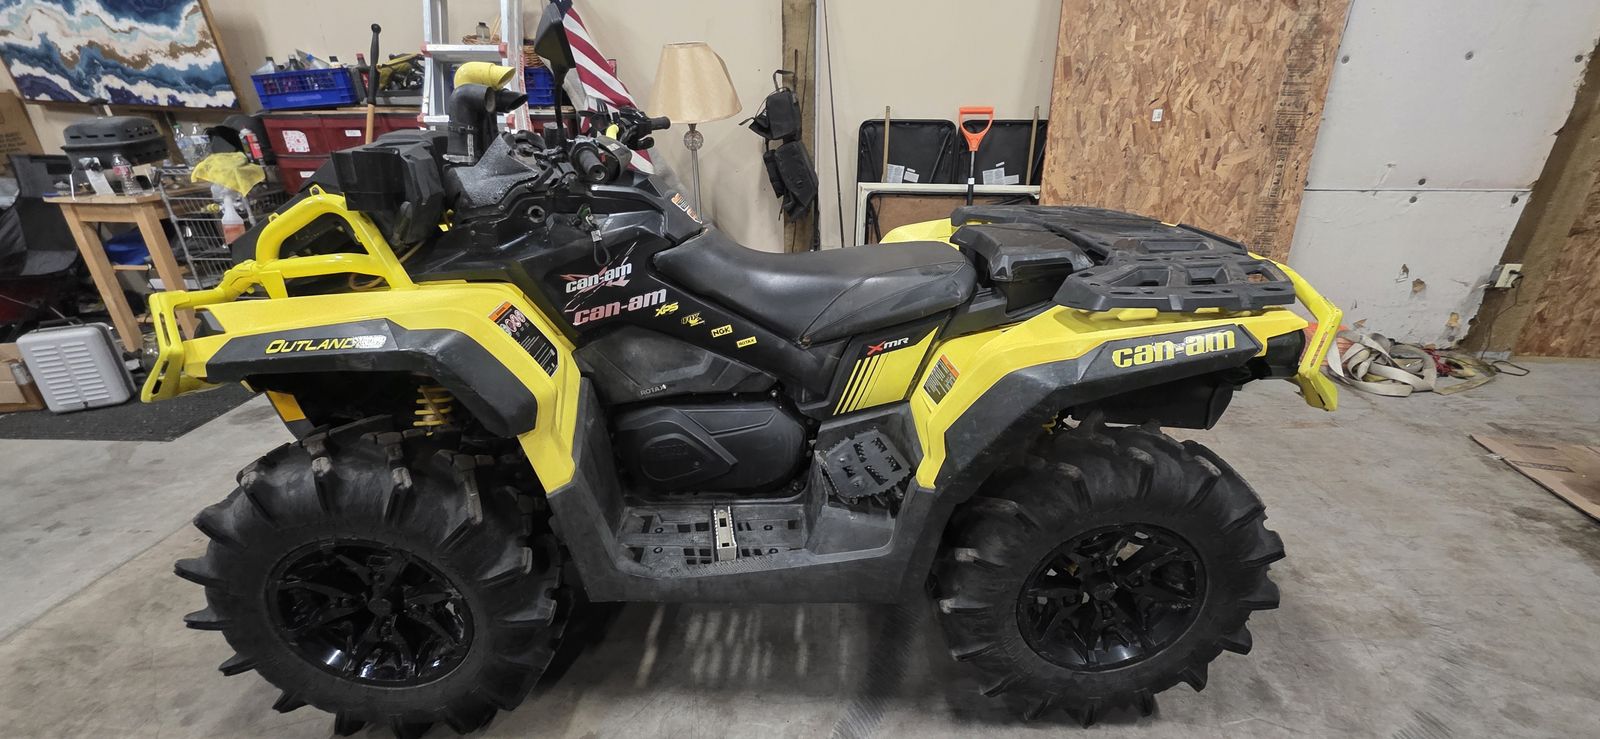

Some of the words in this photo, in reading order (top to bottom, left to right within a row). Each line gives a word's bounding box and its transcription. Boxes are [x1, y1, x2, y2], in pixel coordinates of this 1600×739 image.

[573, 289, 668, 325] can-am
[712, 325, 731, 337] NGK
[1112, 330, 1235, 368] can-am
